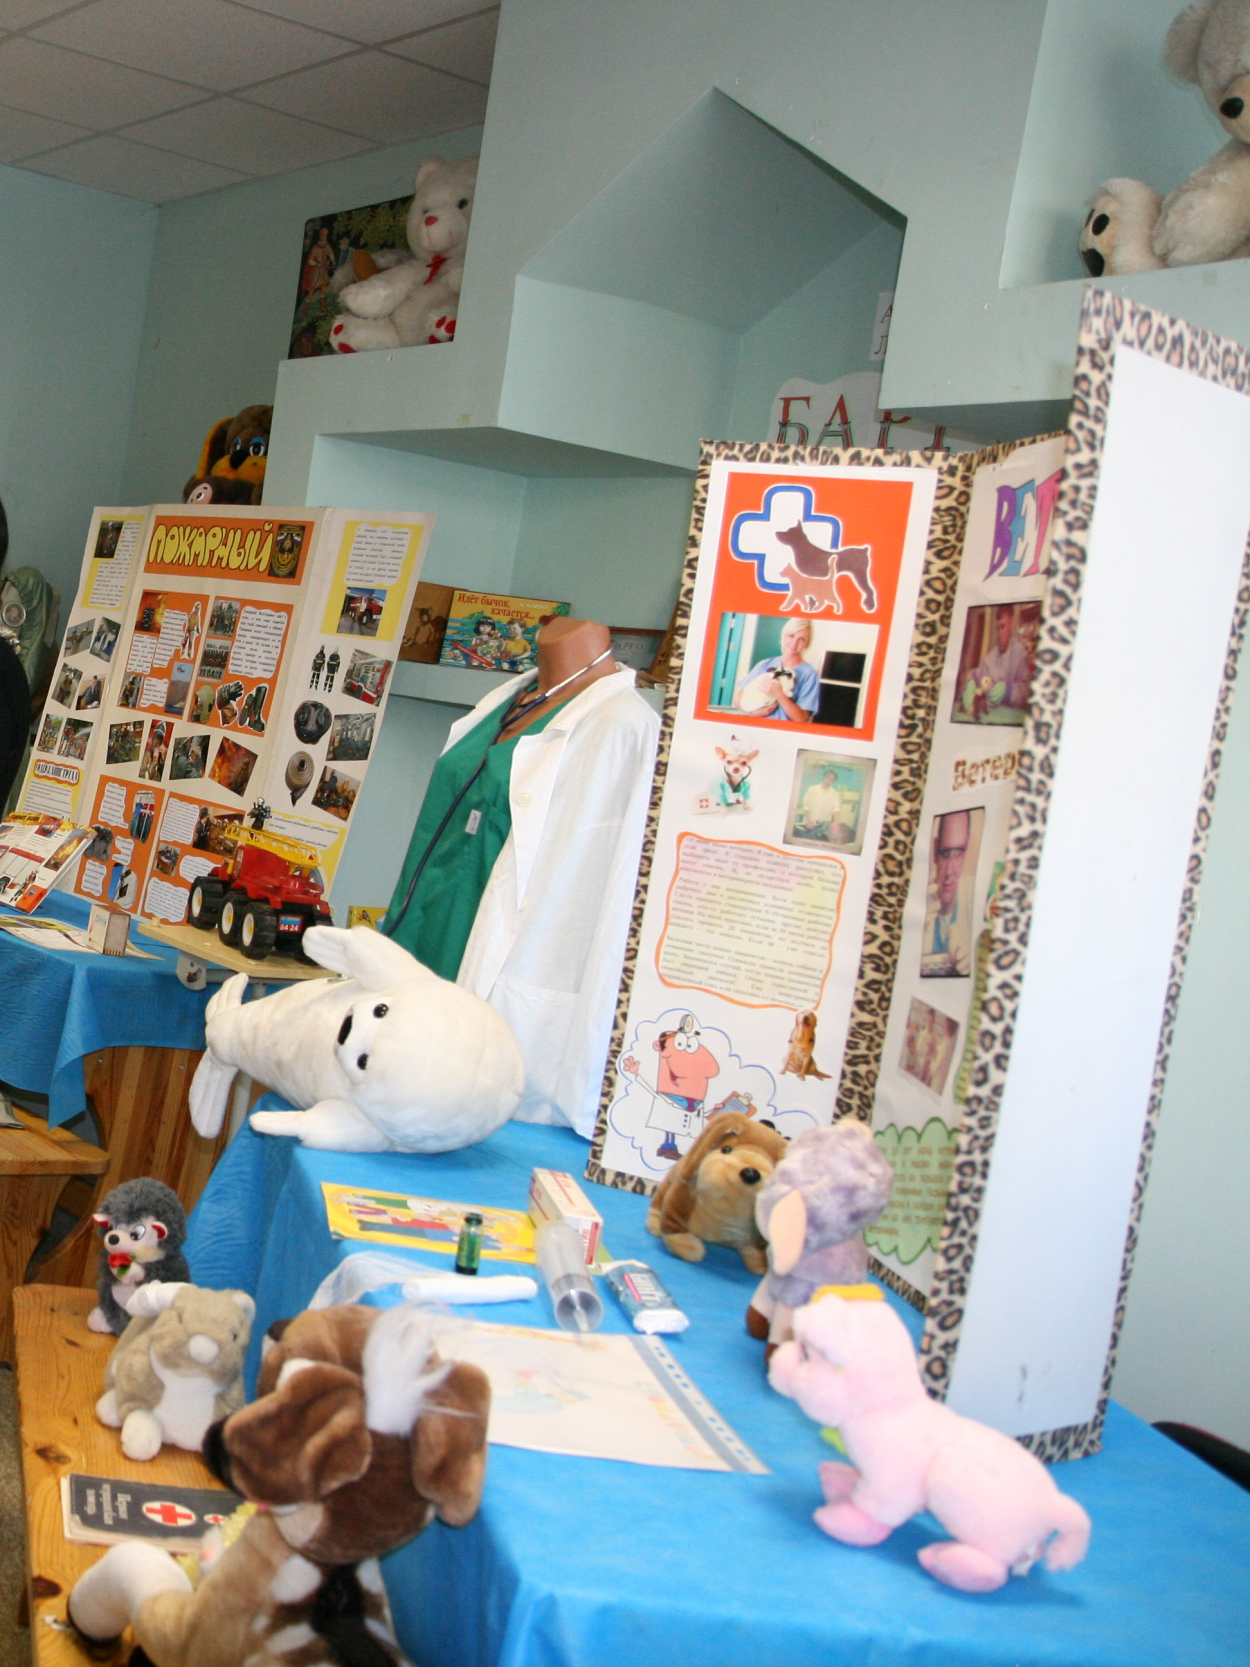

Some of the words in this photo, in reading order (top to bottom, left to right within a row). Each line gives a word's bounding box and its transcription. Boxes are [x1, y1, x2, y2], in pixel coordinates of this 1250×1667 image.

[982, 468, 1065, 582] ВЕТ
[149, 520, 274, 573] ПОЖАРНЫЙ
[458, 593, 479, 604] Идёт
[480, 595, 510, 608] бычок,
[491, 608, 535, 620] качается...
[290, 924, 298, 932] 24
